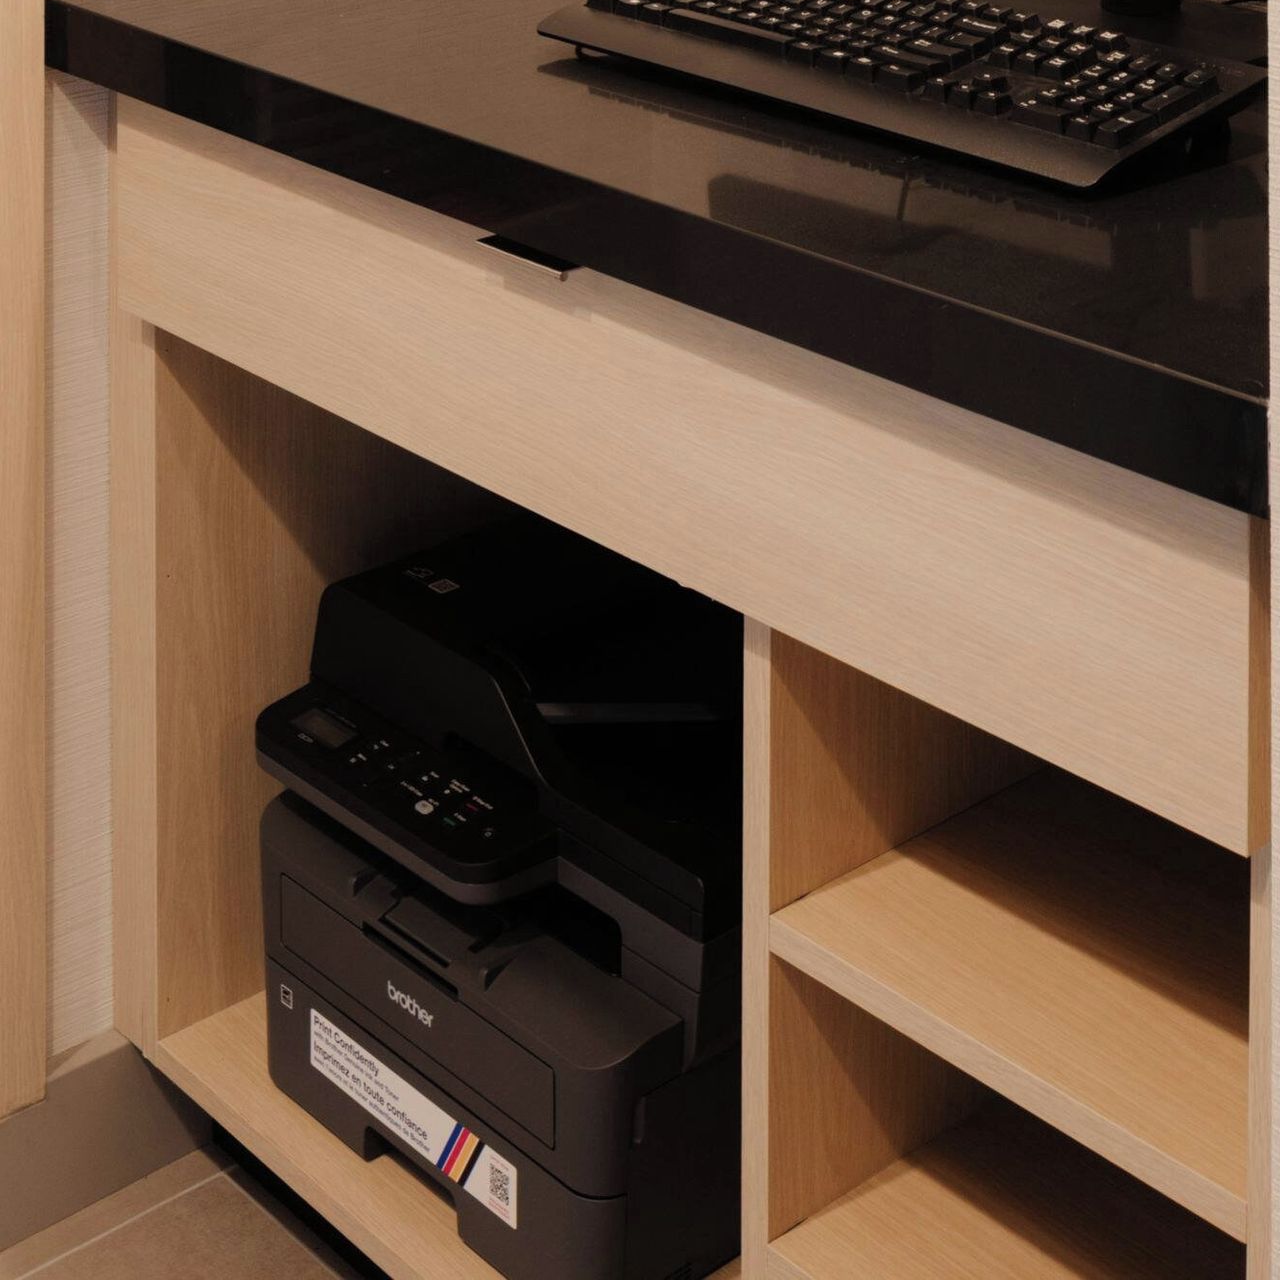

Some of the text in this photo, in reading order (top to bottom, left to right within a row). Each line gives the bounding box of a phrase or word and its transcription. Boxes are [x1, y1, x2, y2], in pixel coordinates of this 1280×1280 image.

[387, 980, 434, 1027] brother
[313, 1015, 380, 1077] Print Confidently
[313, 1040, 428, 1140] Imprimez en toute confiance
